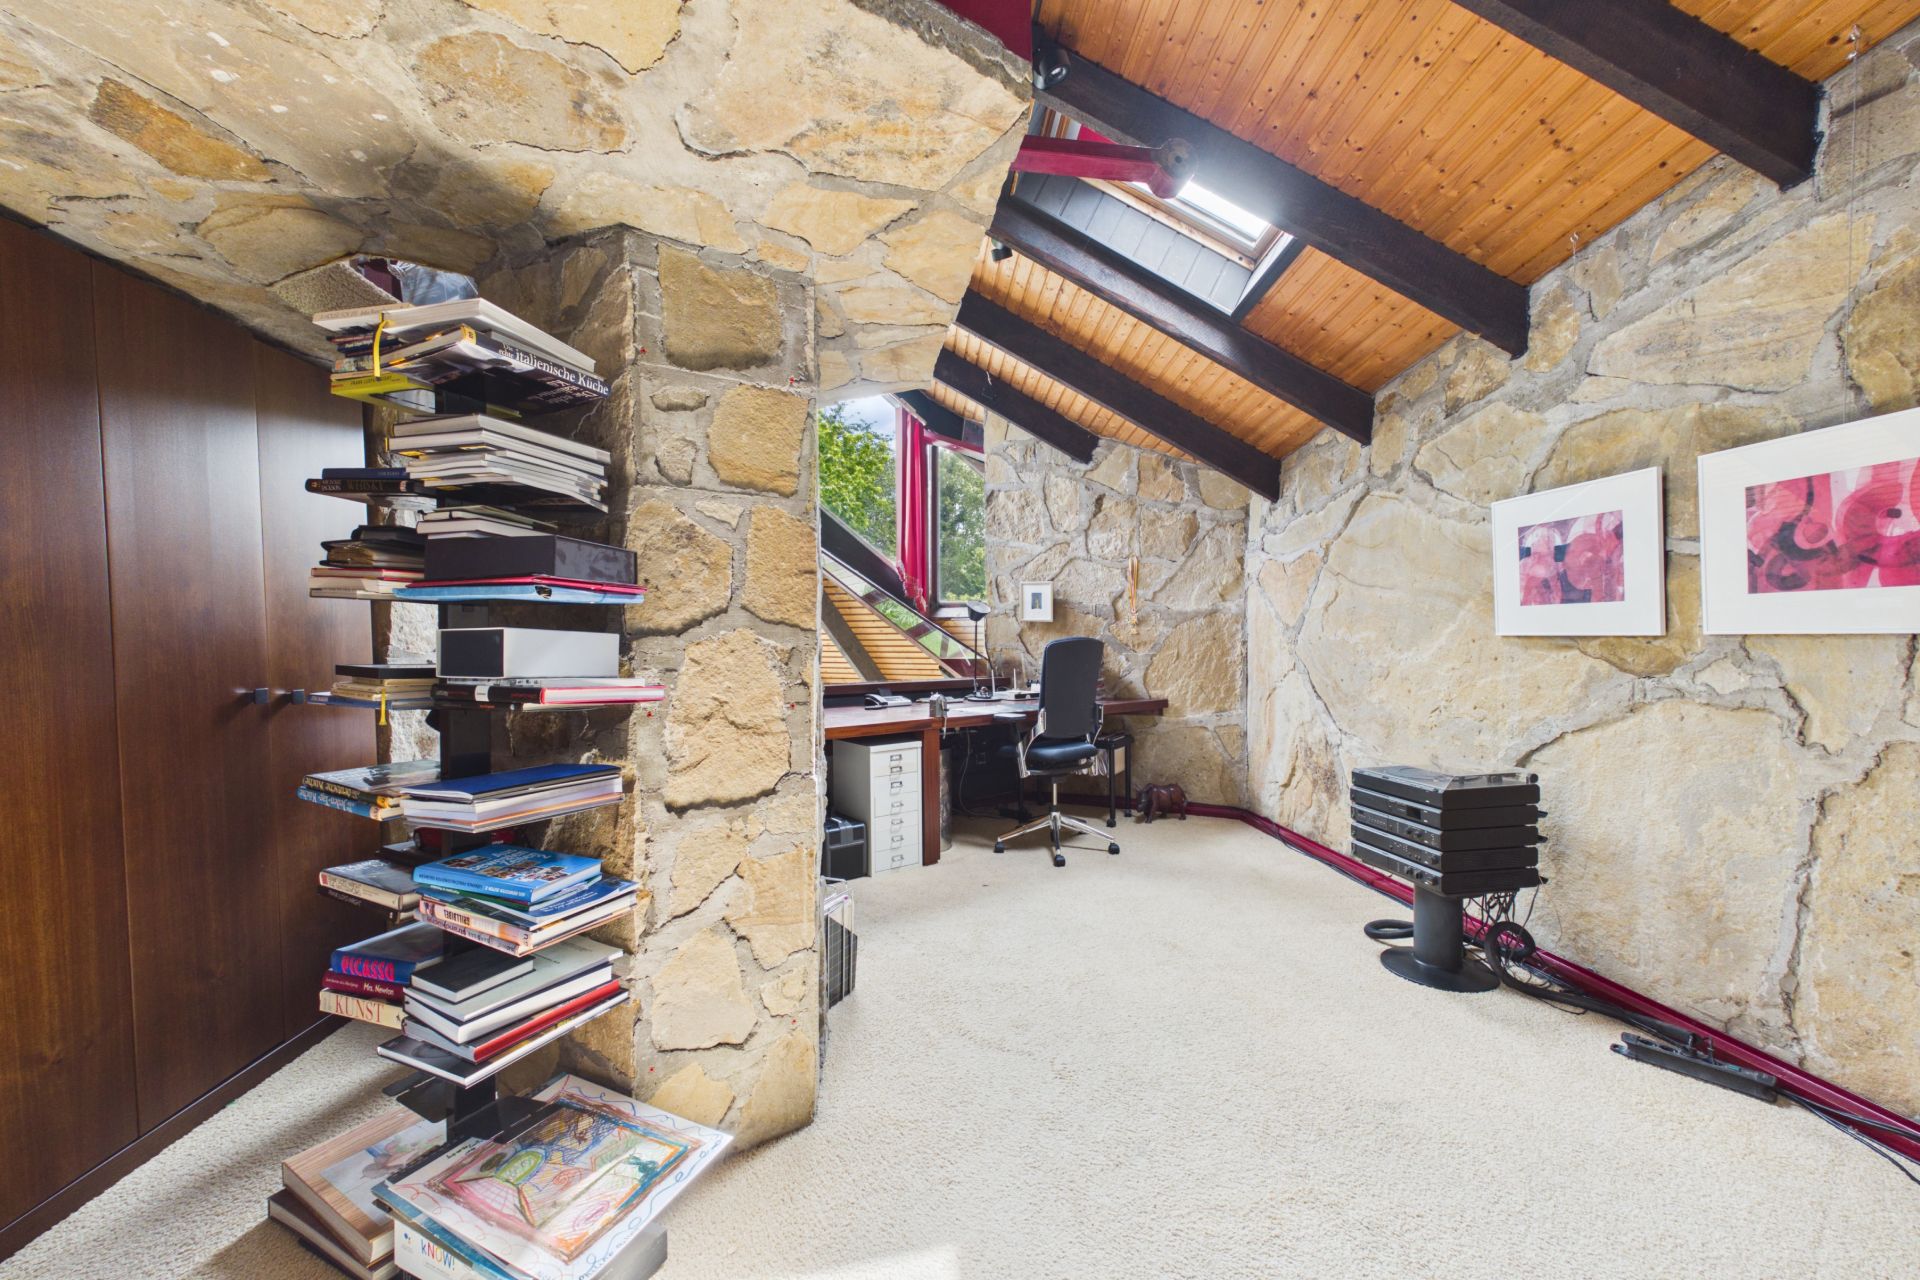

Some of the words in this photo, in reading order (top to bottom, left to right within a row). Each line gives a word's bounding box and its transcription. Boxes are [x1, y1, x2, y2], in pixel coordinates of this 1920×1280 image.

[498, 348, 513, 358] echte
[515, 348, 576, 382] italienische
[578, 372, 609, 395] Küche
[341, 955, 395, 982] PICASSO
[374, 984, 395, 996] Newton
[335, 994, 385, 1023] KUNST
